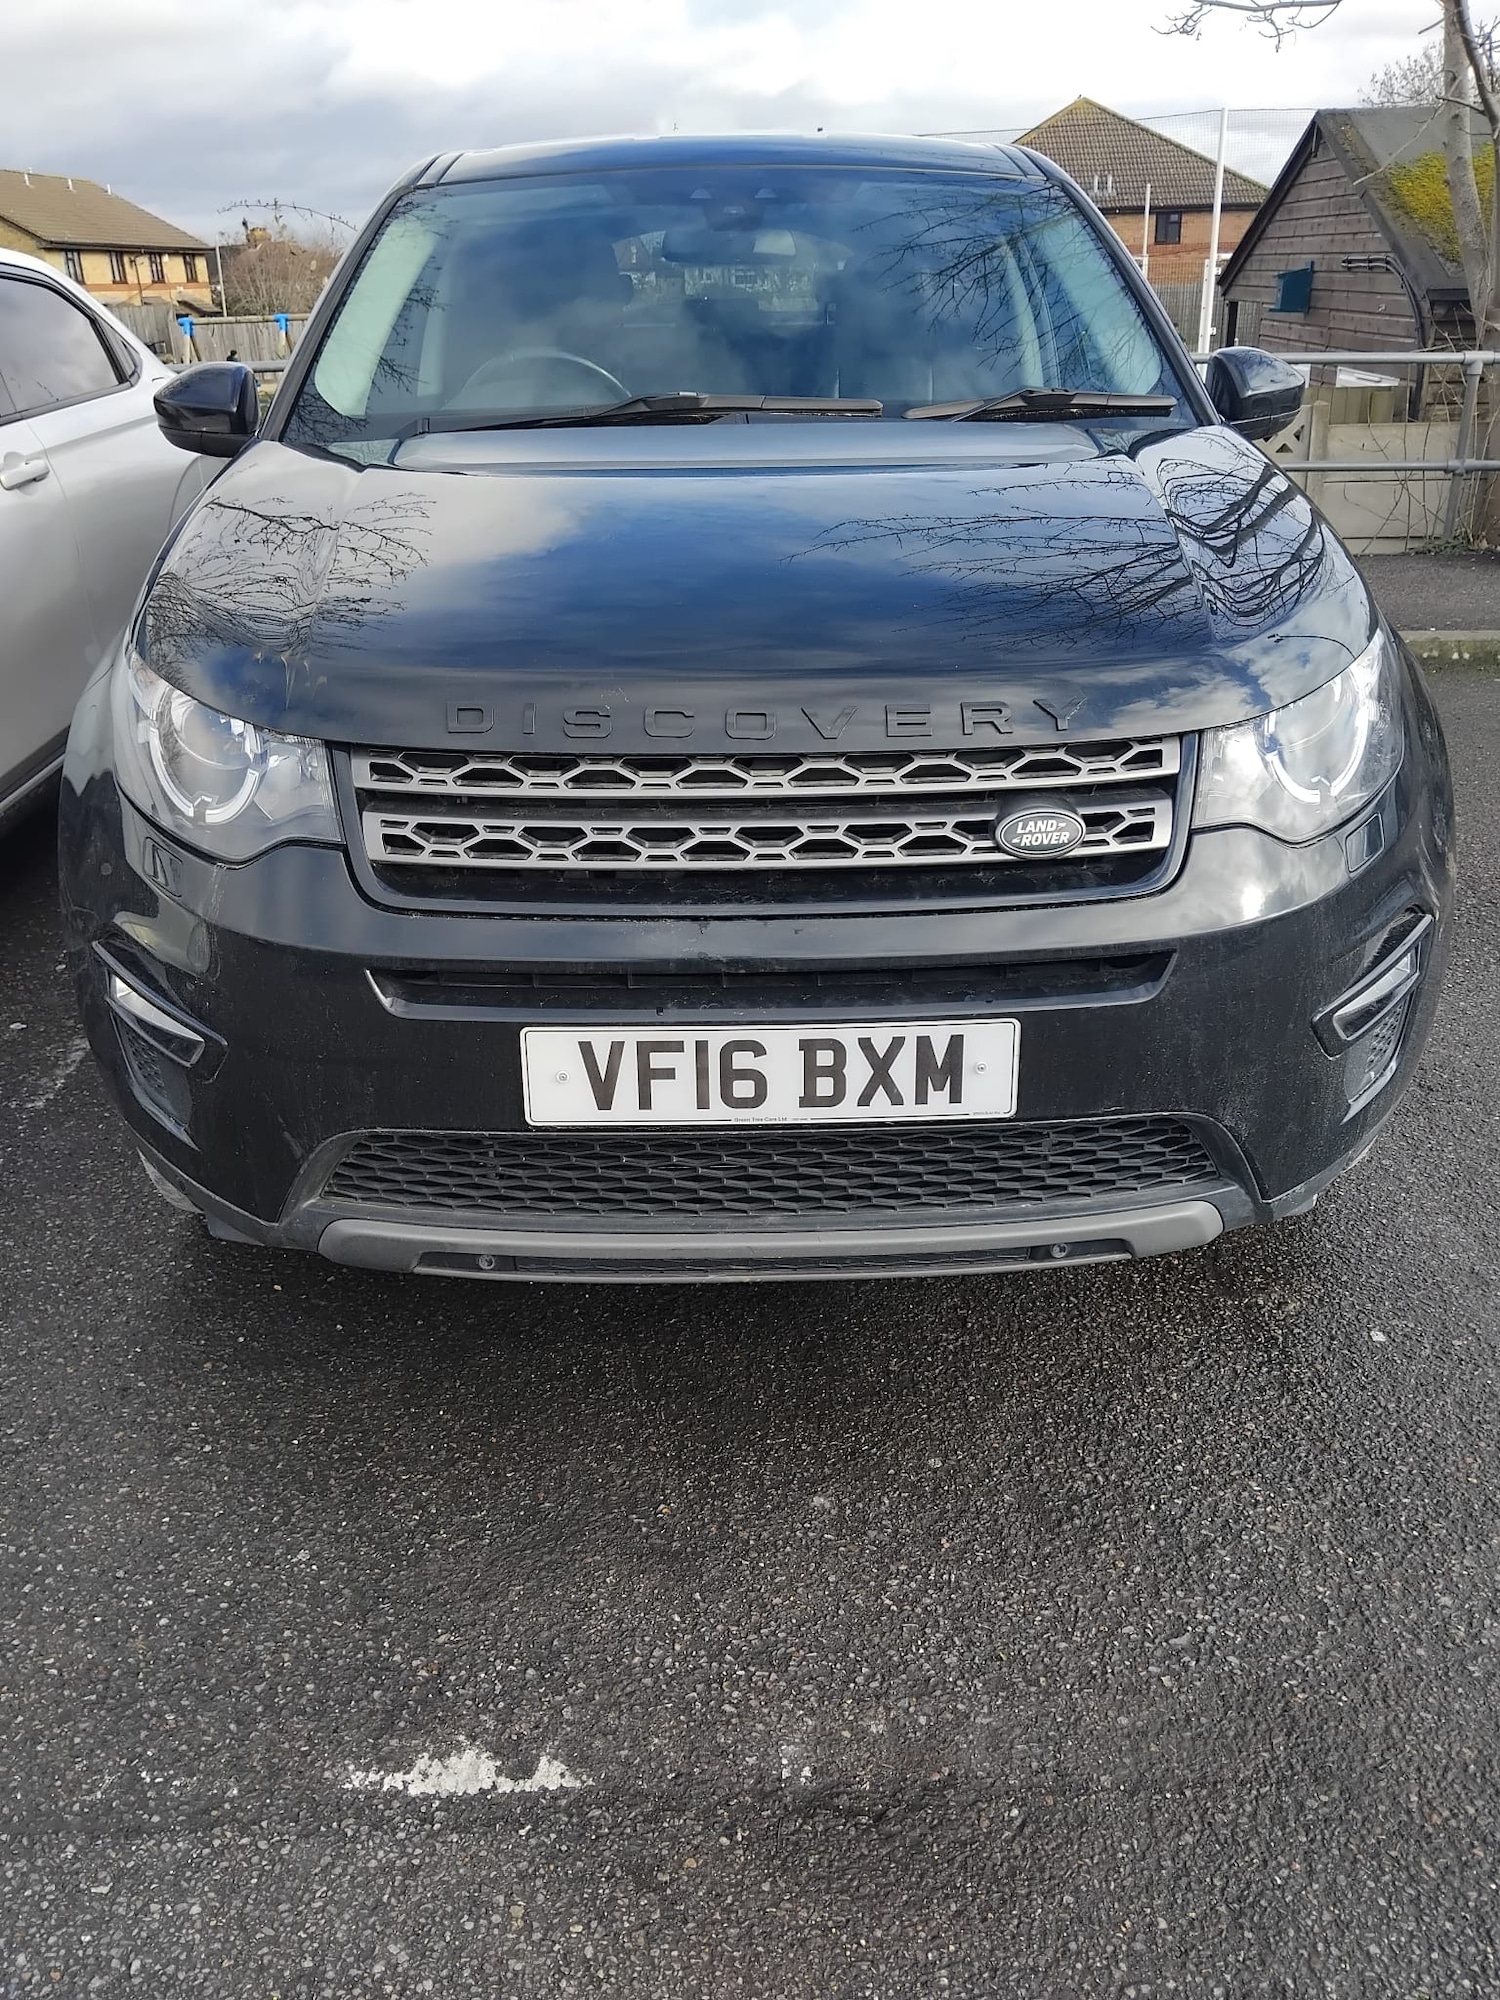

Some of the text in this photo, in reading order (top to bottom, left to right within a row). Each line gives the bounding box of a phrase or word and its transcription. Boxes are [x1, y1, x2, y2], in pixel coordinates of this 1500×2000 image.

[446, 696, 1088, 739] DISCOVERY
[1016, 820, 1057, 834] LAND
[1020, 832, 1071, 846] ROVER
[578, 1034, 965, 1110] VF16 BXM
